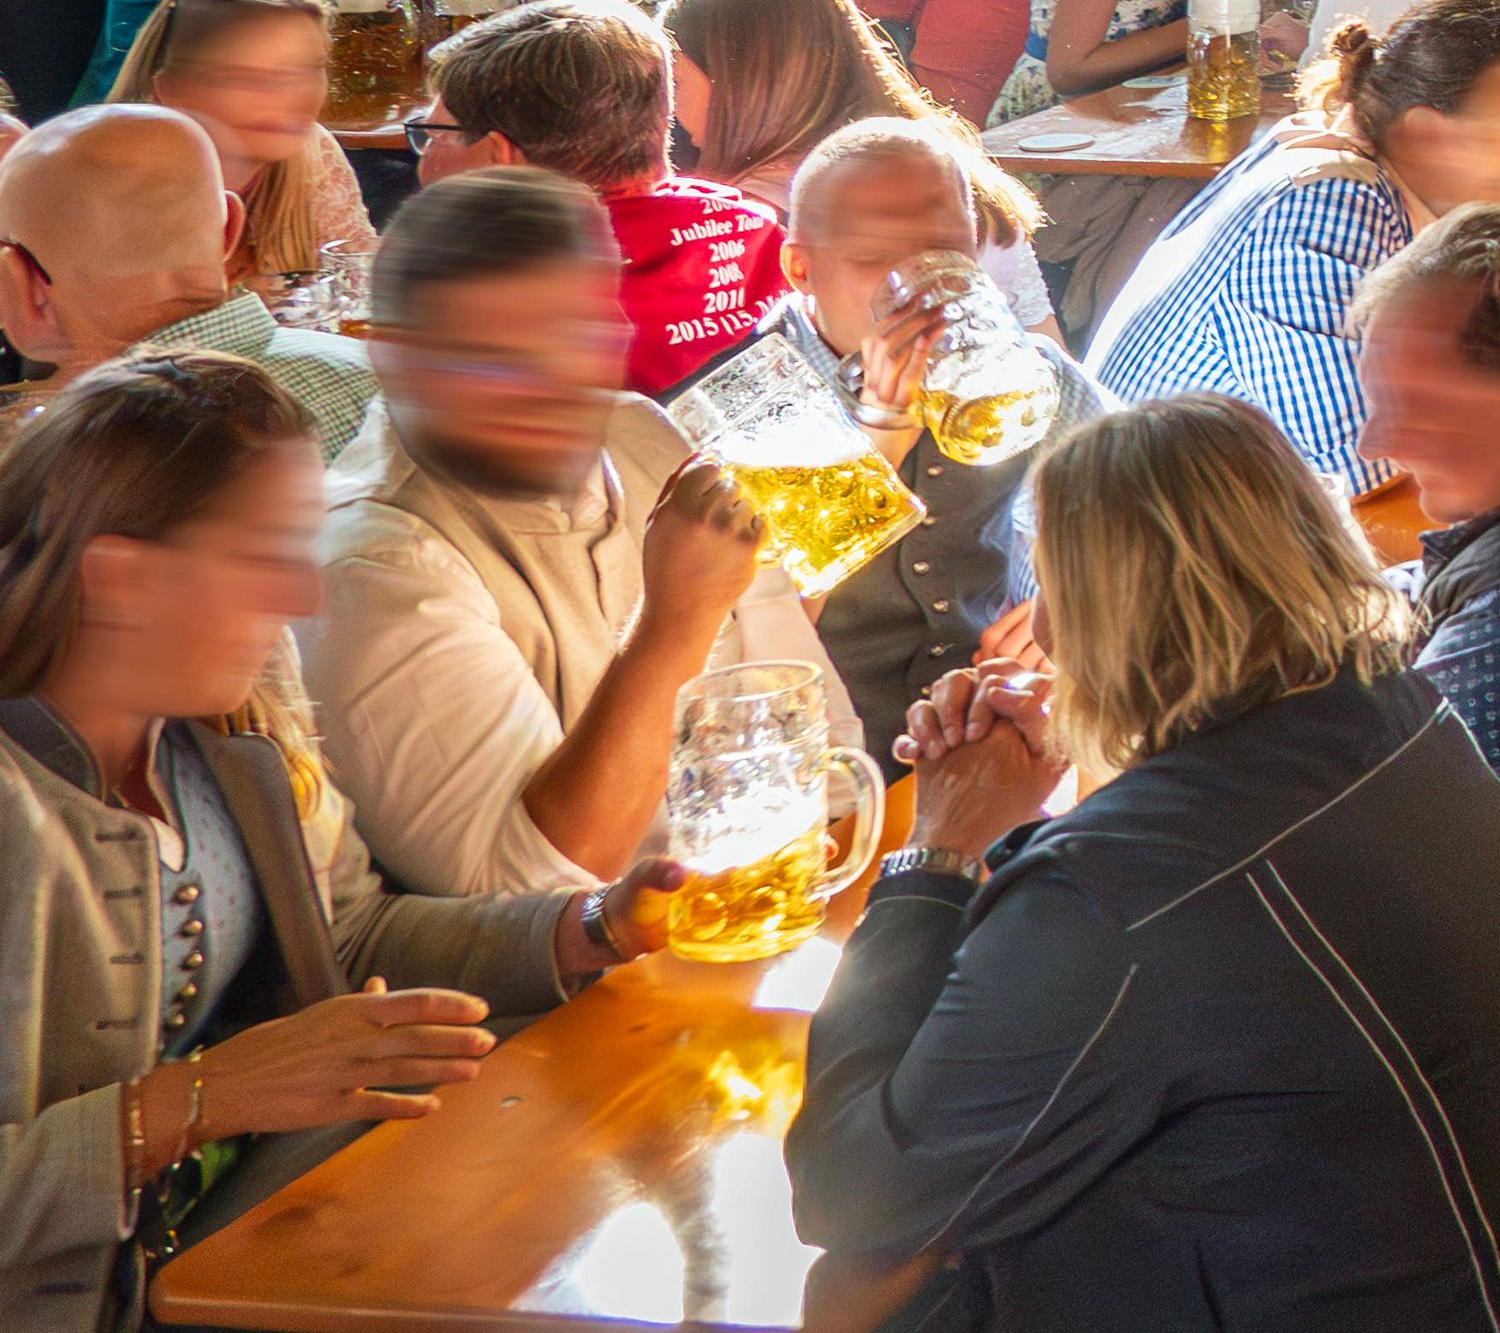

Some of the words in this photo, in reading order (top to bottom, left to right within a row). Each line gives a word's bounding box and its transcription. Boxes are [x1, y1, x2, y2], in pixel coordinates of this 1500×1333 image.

[670, 219, 733, 247] Jubilee
[708, 239, 746, 263] 2006
[708, 262, 745, 289] 2008
[665, 317, 719, 345] 2015
